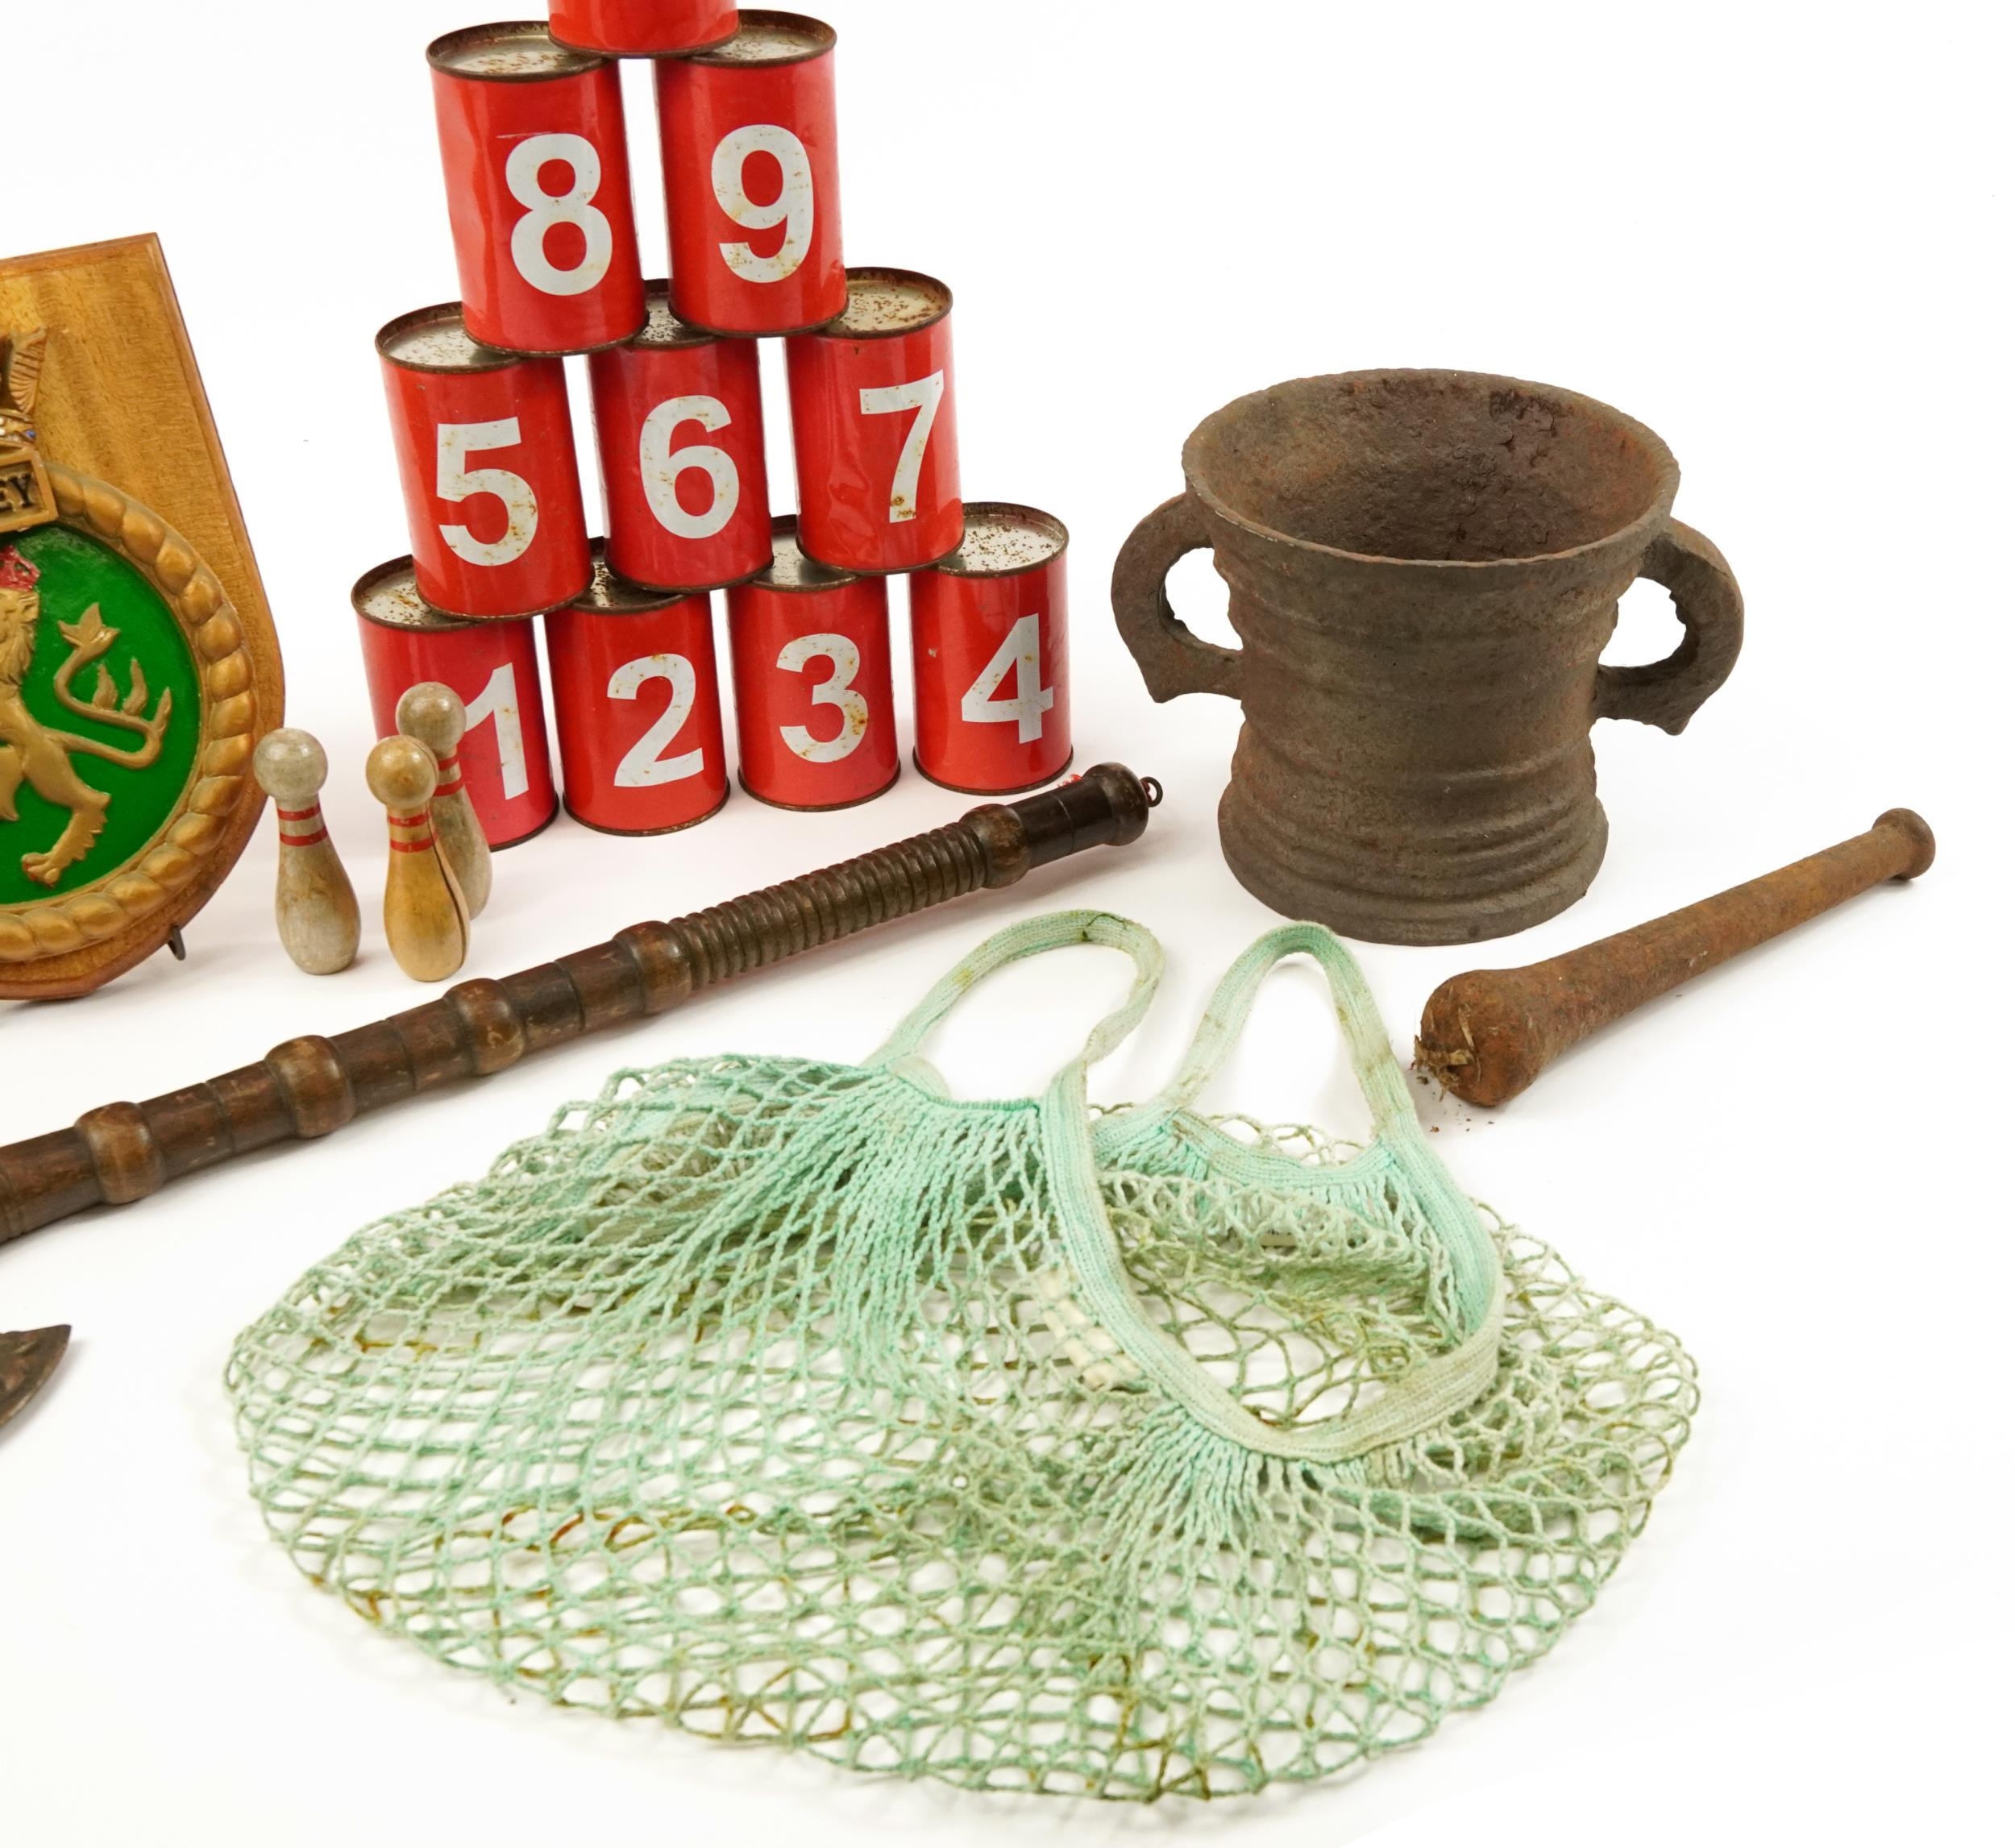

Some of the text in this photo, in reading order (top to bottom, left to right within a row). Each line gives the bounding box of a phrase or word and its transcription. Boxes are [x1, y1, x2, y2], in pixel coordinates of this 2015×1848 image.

[506, 134, 613, 296] 8
[712, 124, 814, 283] 9
[436, 417, 538, 566] 5
[639, 395, 740, 539] 6
[859, 371, 944, 523] 7
[465, 662, 530, 799] 1
[607, 654, 704, 787] 2
[776, 633, 868, 763] 3
[962, 613, 1054, 744] 4
